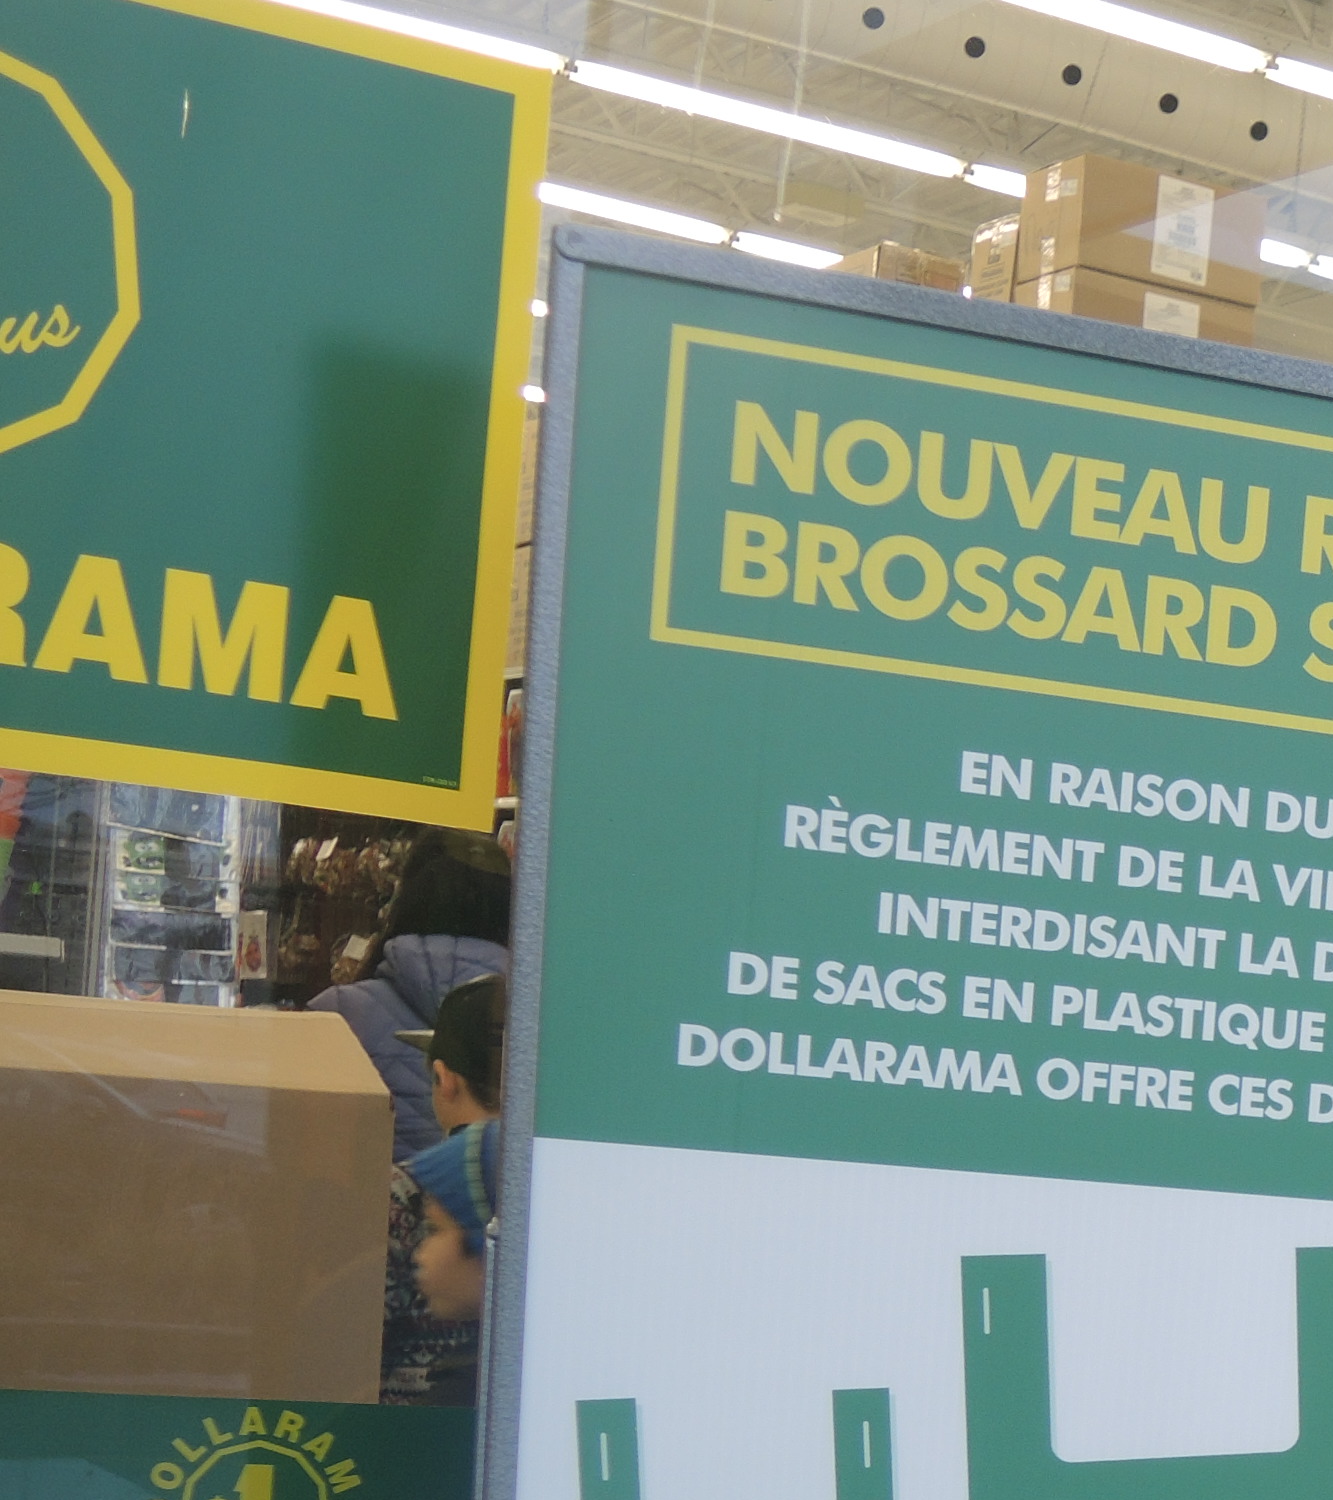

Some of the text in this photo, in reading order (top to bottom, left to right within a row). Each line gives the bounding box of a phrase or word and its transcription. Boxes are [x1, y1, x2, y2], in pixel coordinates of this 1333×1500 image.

[730, 400, 1270, 564] NOUVEAU
[720, 511, 1277, 667] BROSSARD
[959, 750, 1033, 800] EN
[1049, 763, 1249, 828] RAISON
[784, 795, 1104, 884] RÈGLEMENT
[1117, 846, 1183, 893] DE
[1198, 855, 1260, 902] LA
[878, 892, 1225, 969] INTERDISANT
[1239, 933, 1299, 979] LA
[727, 951, 800, 1001] DE
[813, 960, 947, 1016] SACS
[962, 978, 1035, 1026] EN
[1051, 985, 1326, 1053] PLASTIQUE
[676, 1024, 1023, 1097] DOLLARAMA
[1036, 1058, 1195, 1112] OFFRE
[1208, 1076, 1294, 1122] CES
